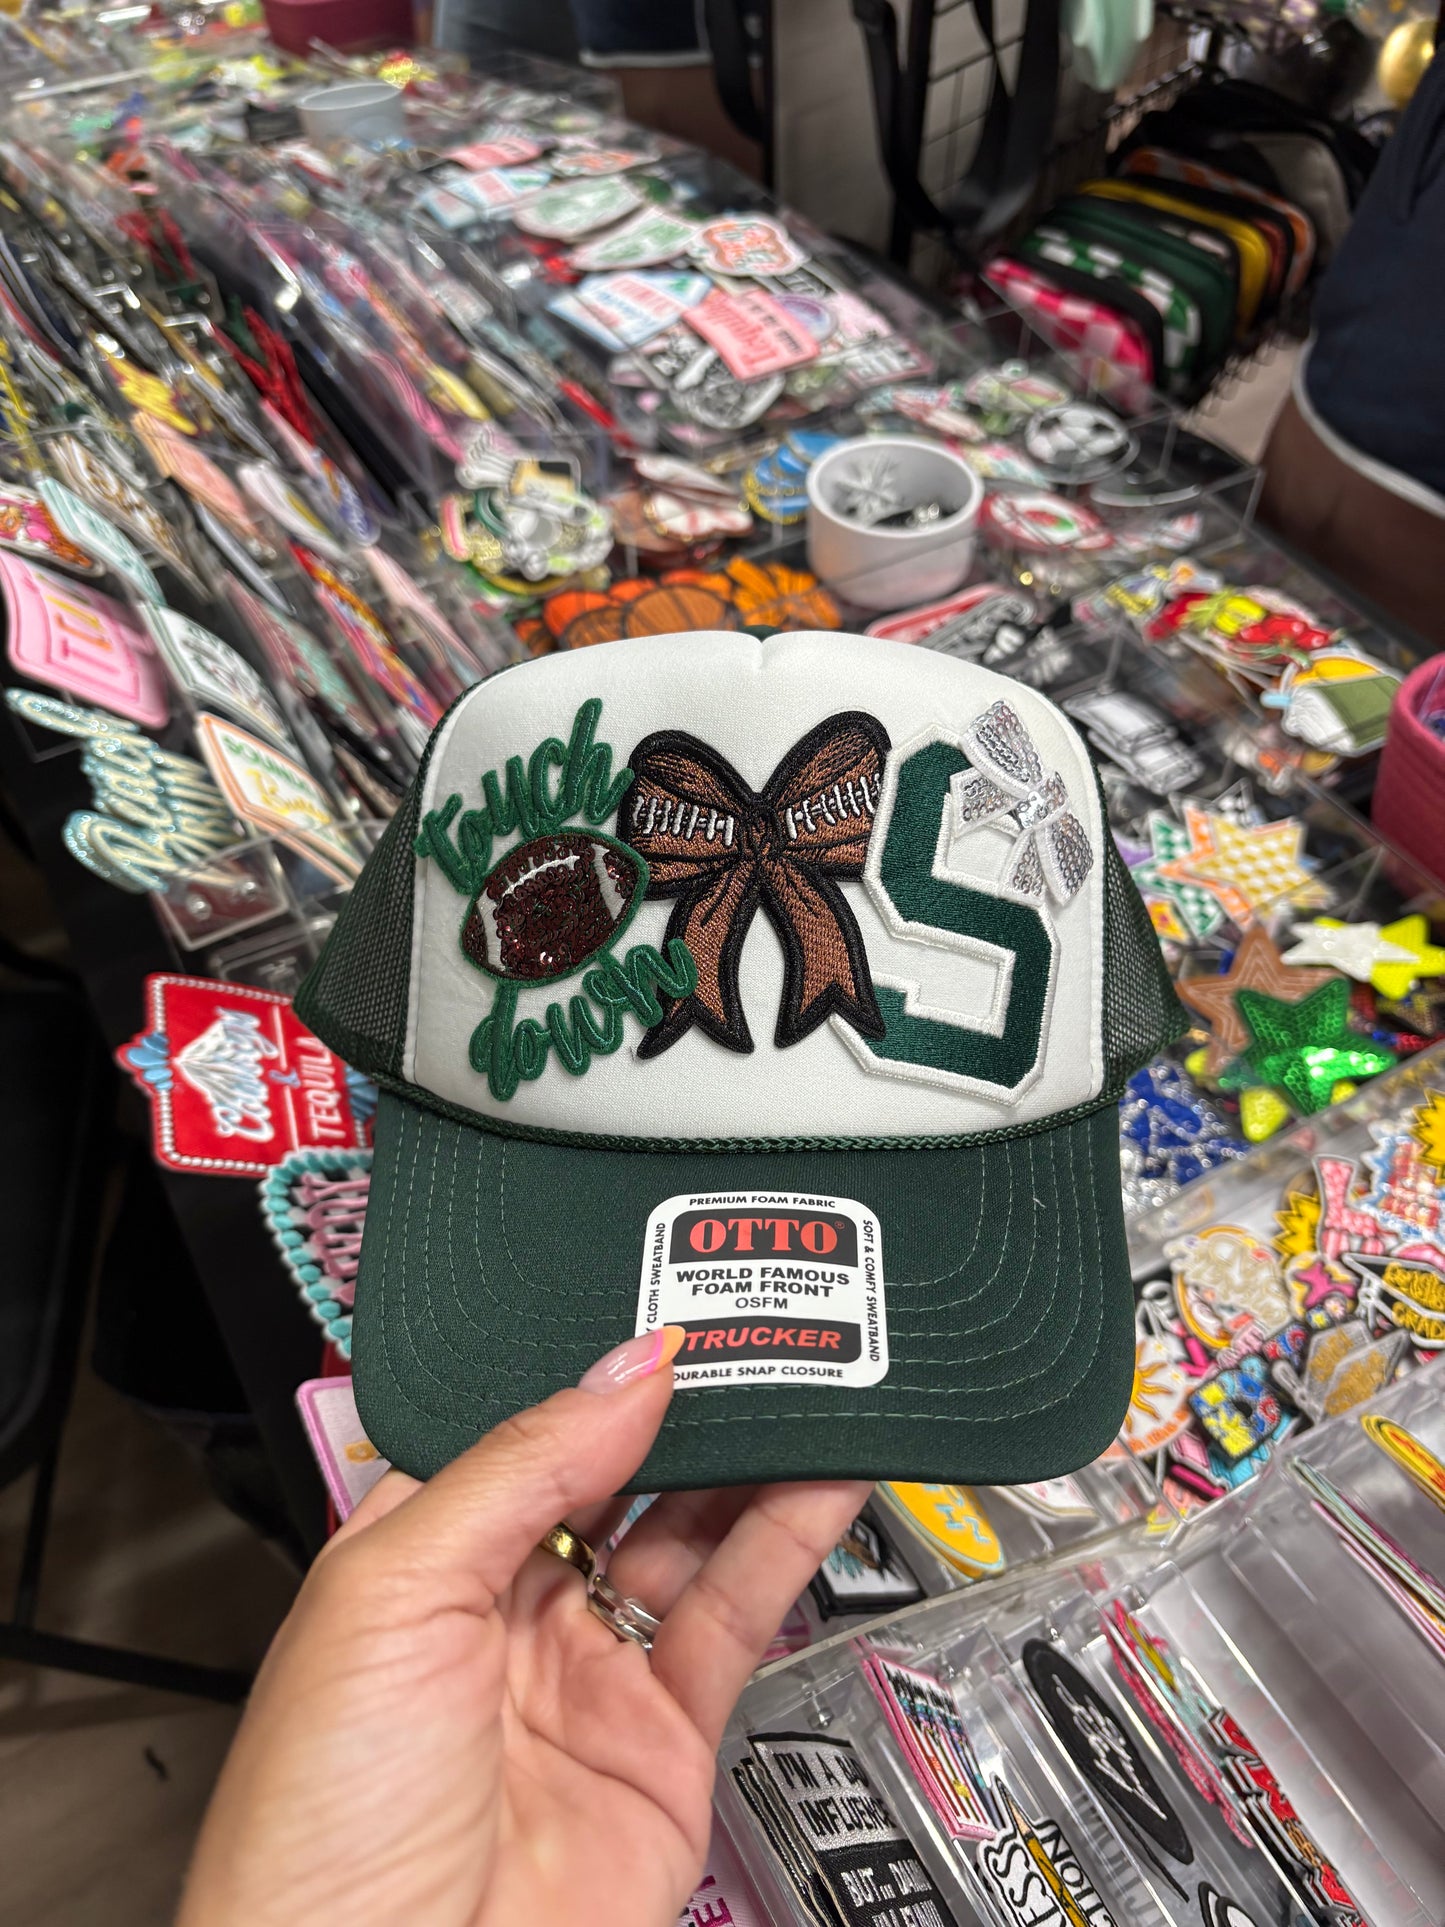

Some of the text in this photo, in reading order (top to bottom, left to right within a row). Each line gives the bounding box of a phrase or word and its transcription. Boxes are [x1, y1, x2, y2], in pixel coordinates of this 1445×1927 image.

[689, 1195, 836, 1208] PREMIUM FOAM FABRIC
[650, 1222, 666, 1285] SWEATBAND
[676, 1267, 850, 1285] WORLD FAMOUS
[691, 1281, 834, 1298] FOAM FRONT
[863, 1219, 880, 1362] SOFT & COMFY SWEATBAND
[647, 1291, 659, 1324] CLOTH
[735, 1297, 788, 1309] OSFM
[685, 1327, 842, 1351] TRUCKER
[737, 1366, 776, 1376] SNAP
[781, 1366, 843, 1378] CLOSURE
[773, 1751, 820, 1789] I'M
[815, 1751, 841, 1787] A
